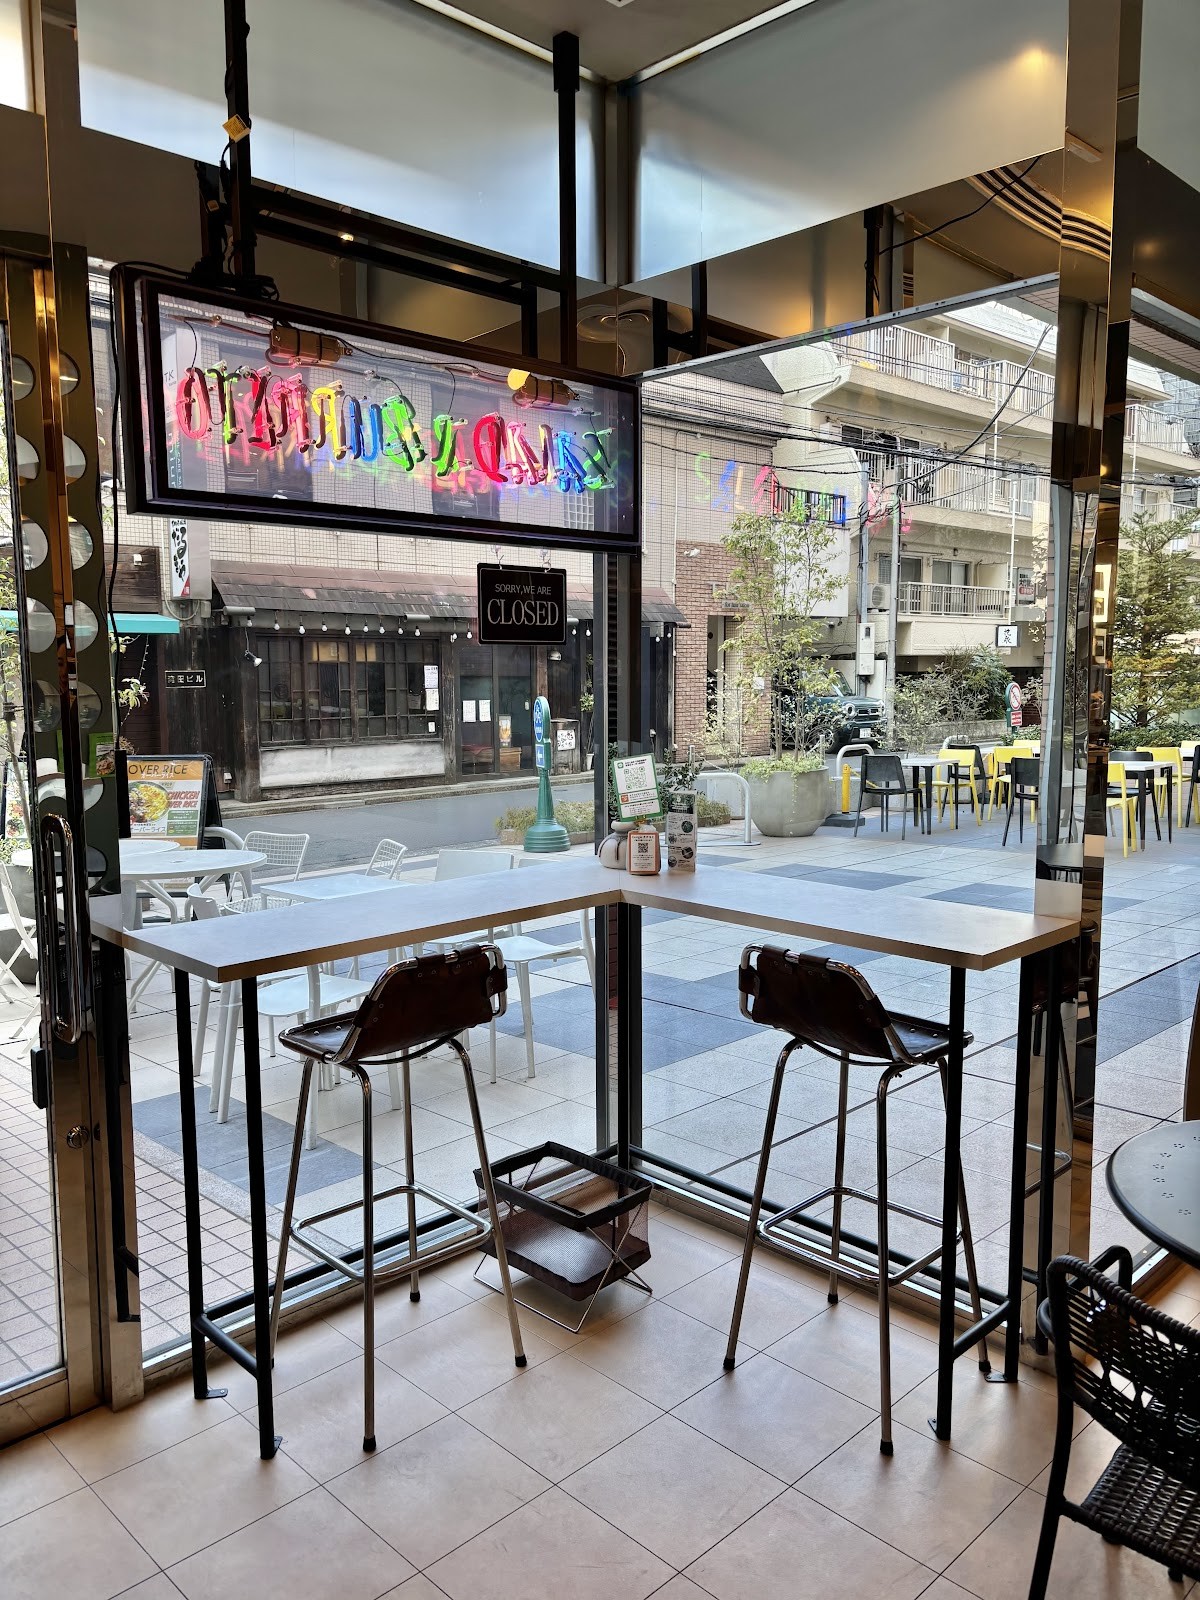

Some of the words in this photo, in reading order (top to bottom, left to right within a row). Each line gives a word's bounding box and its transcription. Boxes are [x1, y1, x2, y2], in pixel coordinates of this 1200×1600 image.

[537, 586, 552, 596] ARE
[487, 598, 559, 626] CLOSED
[128, 764, 160, 775] OVER
[162, 764, 188, 775] RICE
[167, 790, 200, 801] CHICKEN
